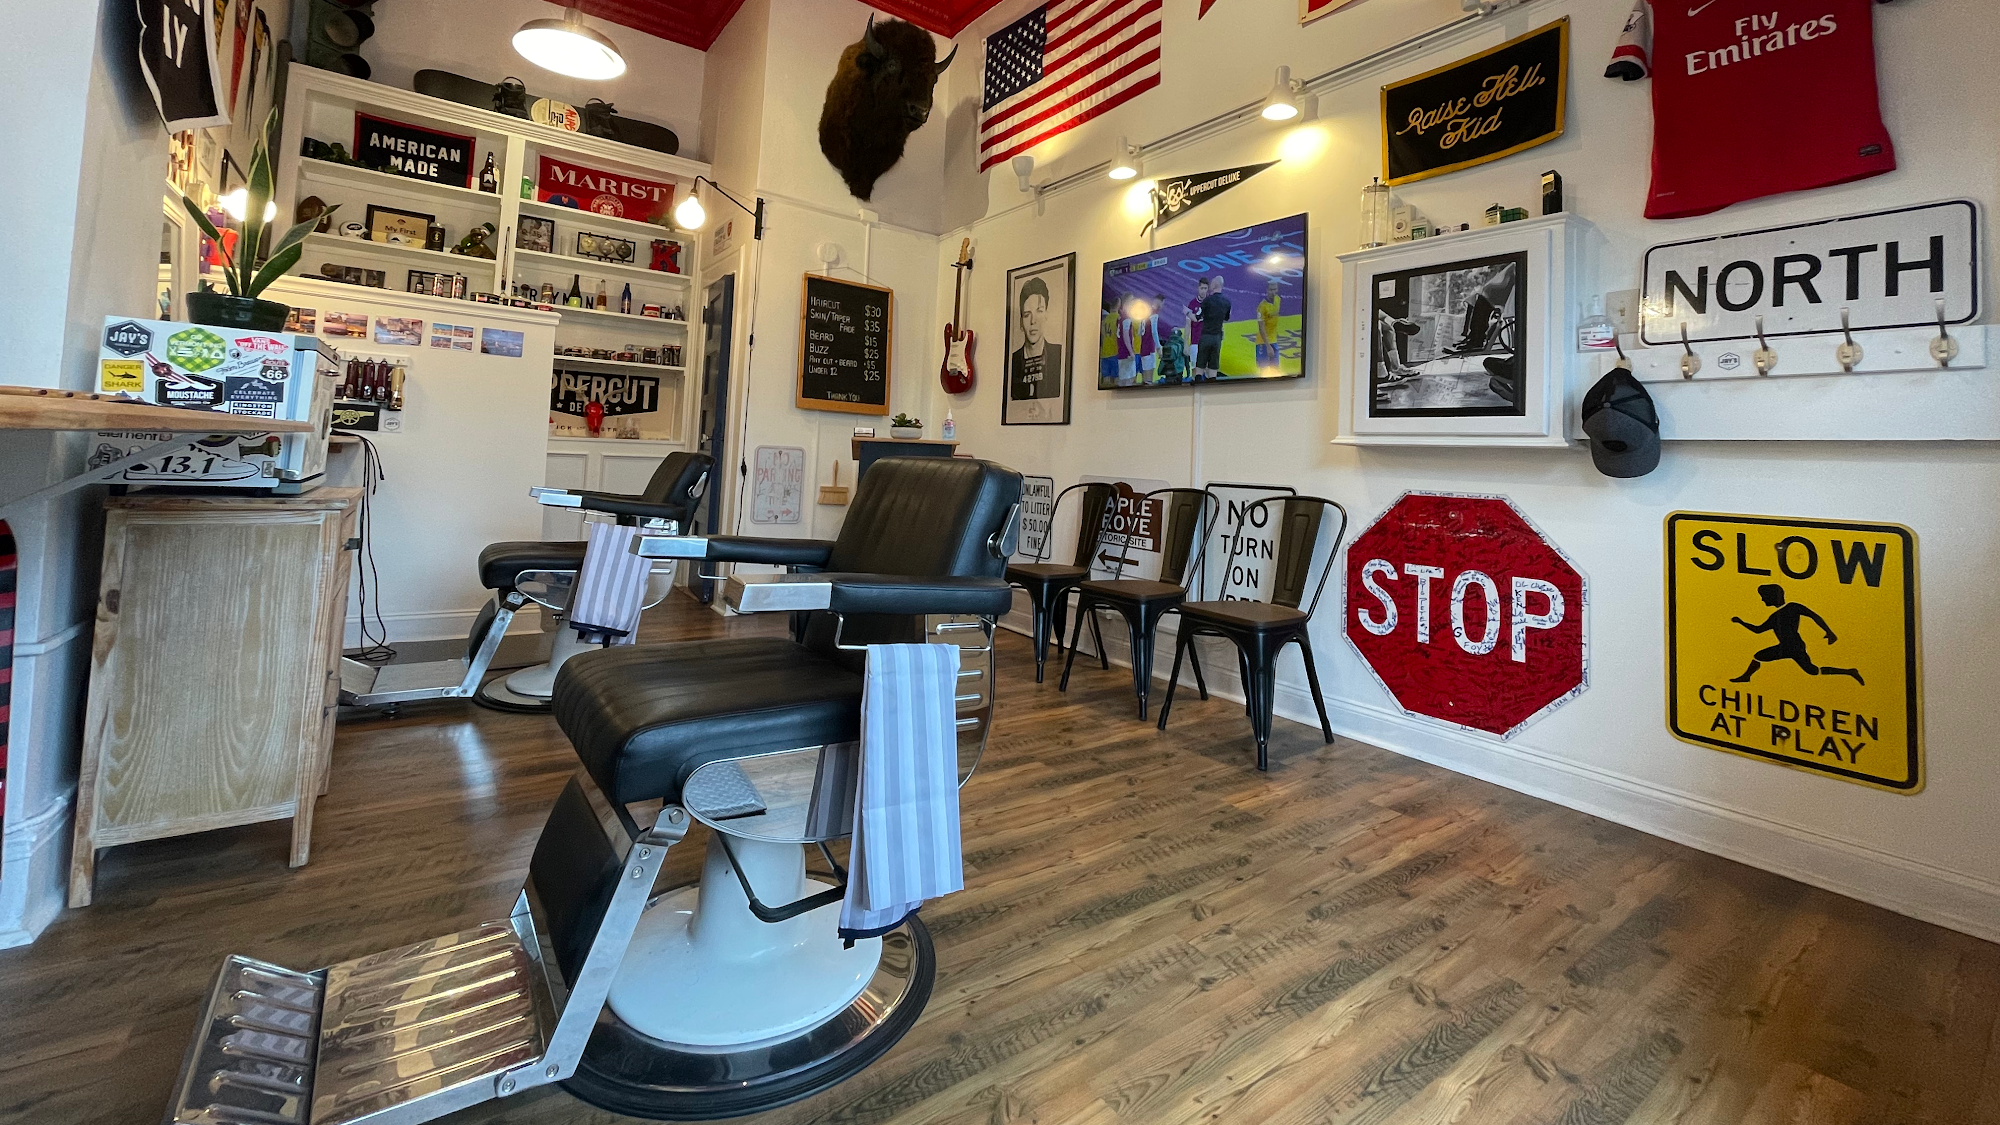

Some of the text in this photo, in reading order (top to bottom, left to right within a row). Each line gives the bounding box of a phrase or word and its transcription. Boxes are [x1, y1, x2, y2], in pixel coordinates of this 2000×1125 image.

[1735, 11, 1778, 36] Fly
[1685, 14, 1837, 76] Emirates
[1396, 97, 1470, 135] Raise
[1440, 107, 1502, 149] Kid
[370, 132, 460, 163] AMERICAN
[390, 155, 438, 177] MADE
[550, 165, 666, 202] MARIST
[1190, 171, 1241, 196] UPPERCUT DELUXE
[385, 225, 417, 236] My First
[1664, 235, 1945, 318] NORTH
[810, 296, 881, 318] HAIRCUT $30
[109, 331, 148, 344] JAY'S
[840, 323, 855, 334] FADE
[864, 320, 880, 333] $35
[809, 330, 878, 348] BEARD $15
[864, 348, 879, 360] $25
[266, 370, 283, 379] 66
[863, 370, 881, 382] $25
[167, 391, 214, 399] MOUSTACHE
[161, 455, 216, 474] 13.1
[1022, 501, 1050, 516] TO LITTER
[1228, 500, 1268, 528] NO
[1027, 536, 1042, 550] FINE
[1129, 538, 1147, 547] SITE
[1221, 534, 1274, 560] TURN
[1690, 530, 1887, 587] SLOW
[1232, 566, 1259, 589] ON
[1358, 558, 1565, 663] STOP
[1698, 684, 1878, 741] CHILDREN
[1711, 712, 1866, 764] AT PLAY
